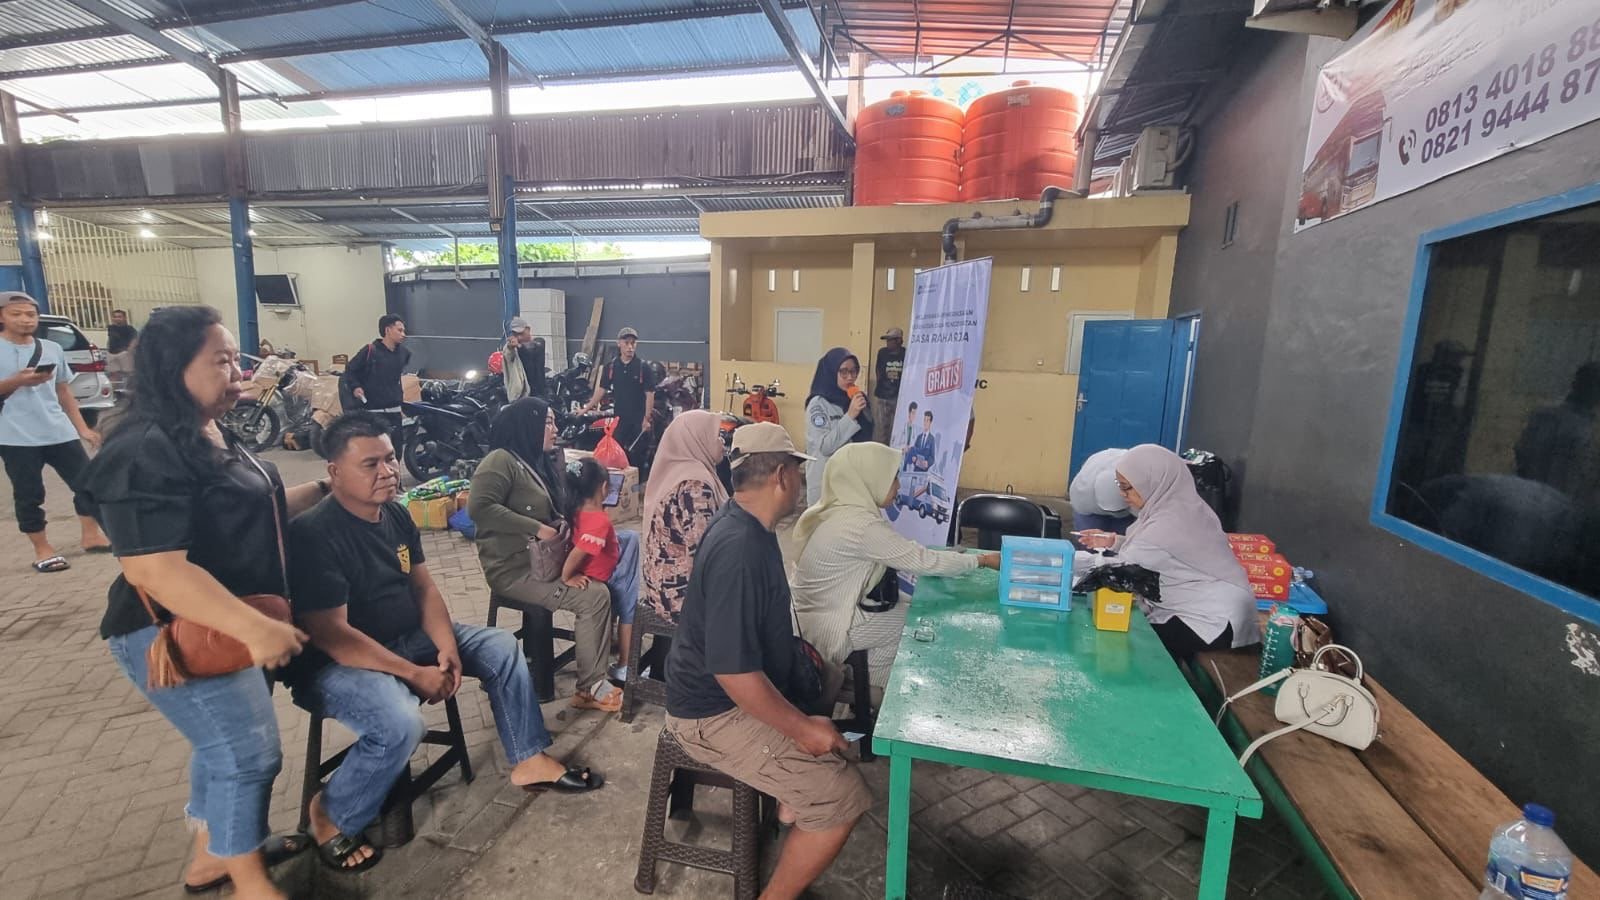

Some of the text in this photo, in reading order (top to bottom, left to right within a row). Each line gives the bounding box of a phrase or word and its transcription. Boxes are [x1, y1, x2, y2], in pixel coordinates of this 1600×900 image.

[1425, 84, 1479, 133] 0813
[1485, 43, 1558, 101] 4018
[1421, 118, 1472, 164] 0821
[1480, 81, 1551, 138] 9444
[931, 331, 969, 343] RAHARJA
[927, 360, 962, 392] GRATIS
